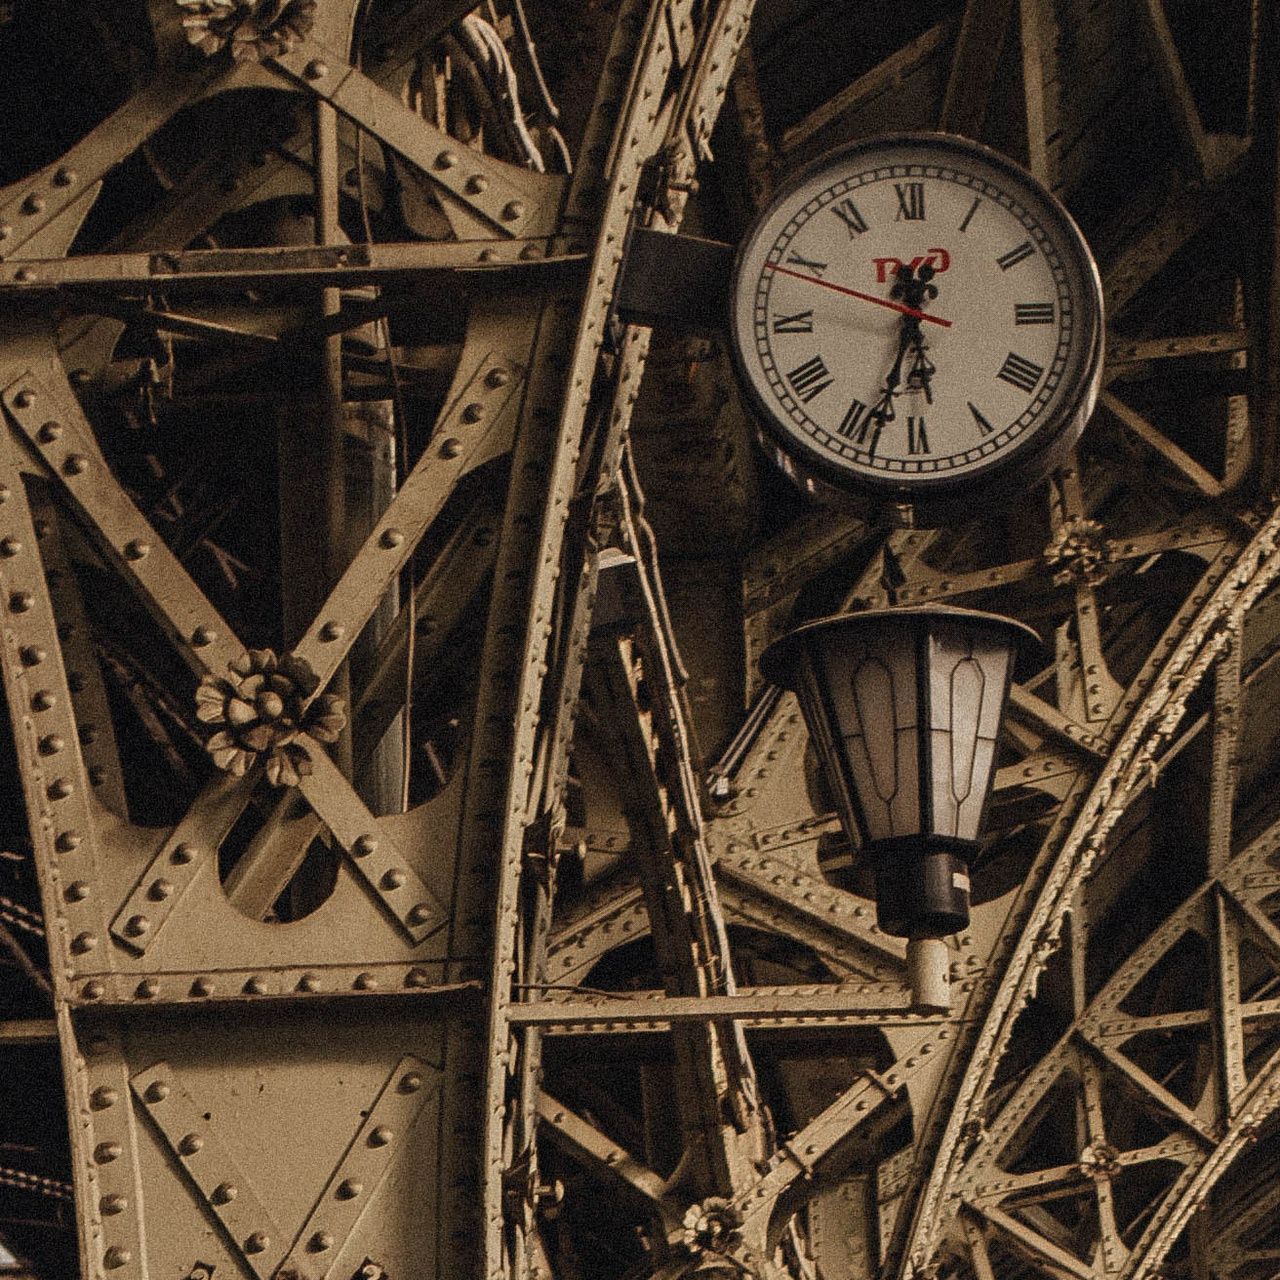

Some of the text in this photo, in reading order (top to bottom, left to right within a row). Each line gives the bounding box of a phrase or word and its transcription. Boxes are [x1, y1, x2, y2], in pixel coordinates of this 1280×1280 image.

[831, 199, 869, 239] XI
[894, 182, 925, 221] XII
[959, 197, 982, 232] I
[787, 249, 828, 278] X
[996, 240, 1035, 272] II
[773, 309, 814, 334] IX
[1014, 303, 1055, 326] III
[786, 355, 835, 404] VIII
[907, 415, 931, 455] VI
[967, 401, 995, 438] V
